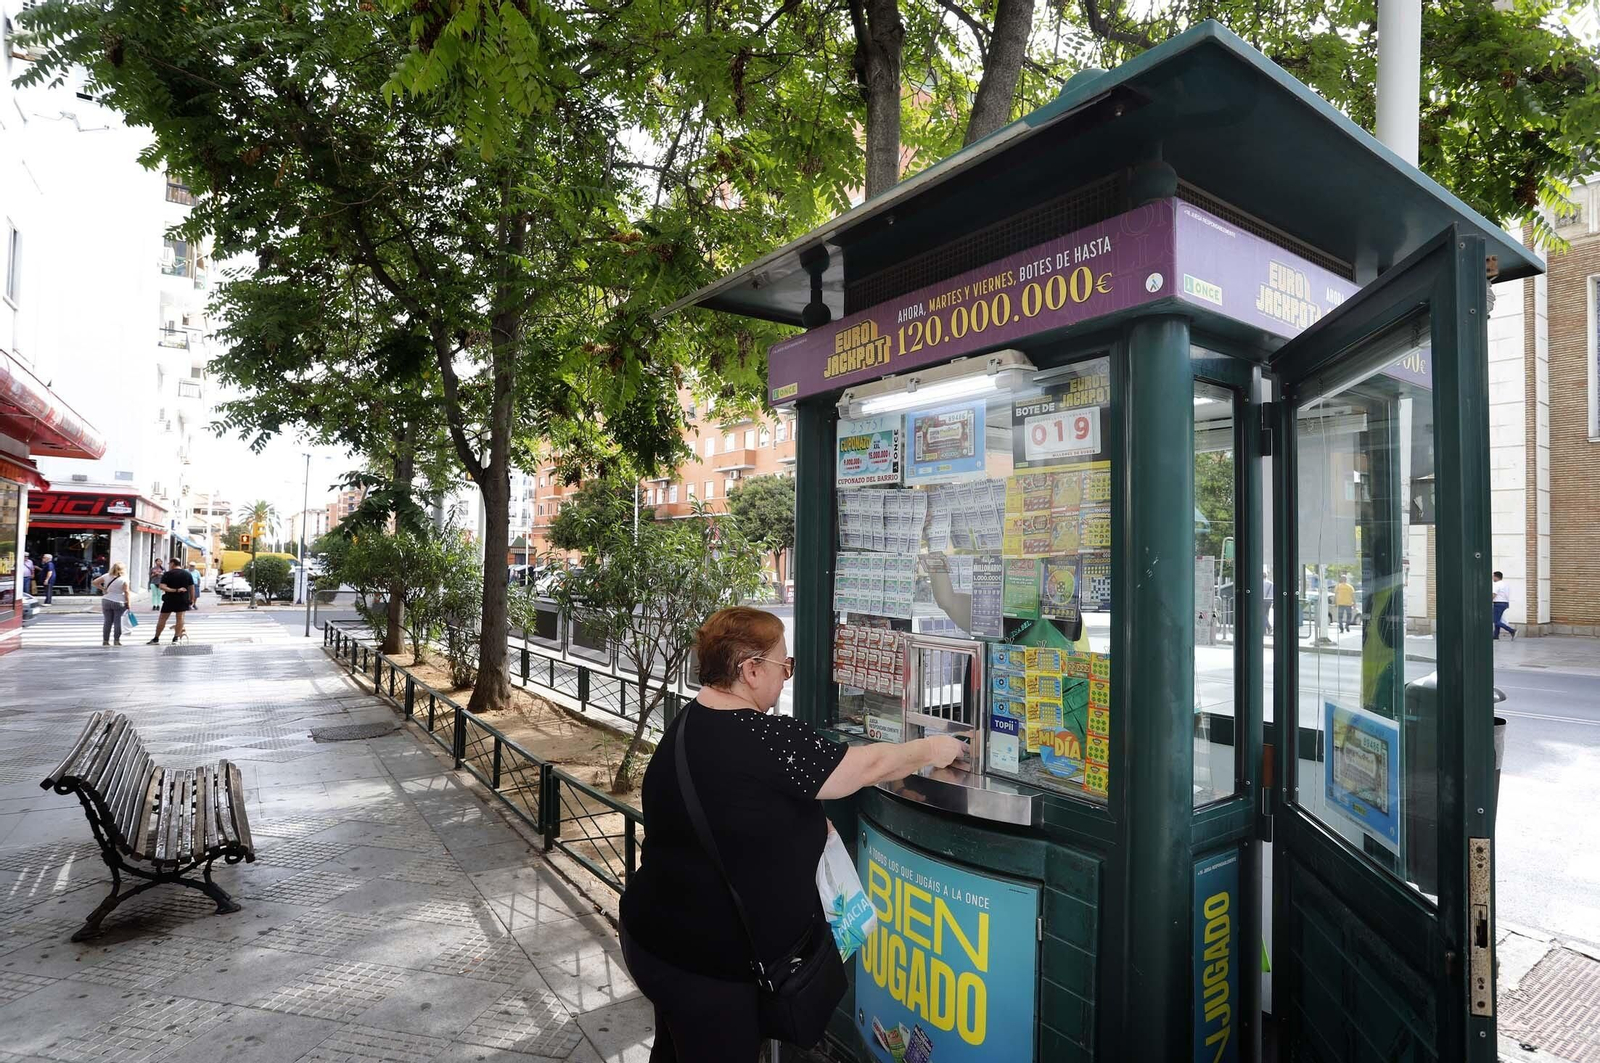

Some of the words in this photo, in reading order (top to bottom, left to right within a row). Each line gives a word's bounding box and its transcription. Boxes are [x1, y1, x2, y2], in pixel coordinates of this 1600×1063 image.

[898, 302, 927, 323] AHORA,
[929, 288, 962, 312] MARTES
[964, 286, 970, 300] Y
[972, 271, 1017, 297] VIERNES,
[1019, 257, 1052, 282] BOTES
[1056, 250, 1070, 270] DE
[1074, 236, 1111, 263] HASTA
[1195, 282, 1220, 301] ONCE
[1269, 260, 1307, 300] EURO
[897, 266, 1114, 356] 120.000.000€
[1256, 284, 1319, 329] JACKPOT
[835, 320, 875, 352] EURO
[824, 336, 888, 378] JACKPOT
[780, 385, 796, 396] ONCE
[1070, 376, 1102, 391] EURO
[1015, 404, 1040, 417] BOTE
[1042, 402, 1055, 413] DE
[1038, 731, 1055, 746] MI
[1055, 736, 1081, 760] DÍA
[872, 847, 888, 866] TODOS
[888, 859, 899, 873] LOS
[900, 866, 913, 880] QUE
[915, 873, 941, 893] JUGÁIS
[943, 885, 949, 896] A
[952, 887, 962, 901] LA
[965, 892, 990, 909] ONCE
[869, 859, 989, 973] BIEN
[1203, 891, 1231, 1027] JUGADO
[862, 924, 987, 1046] JUGADO
